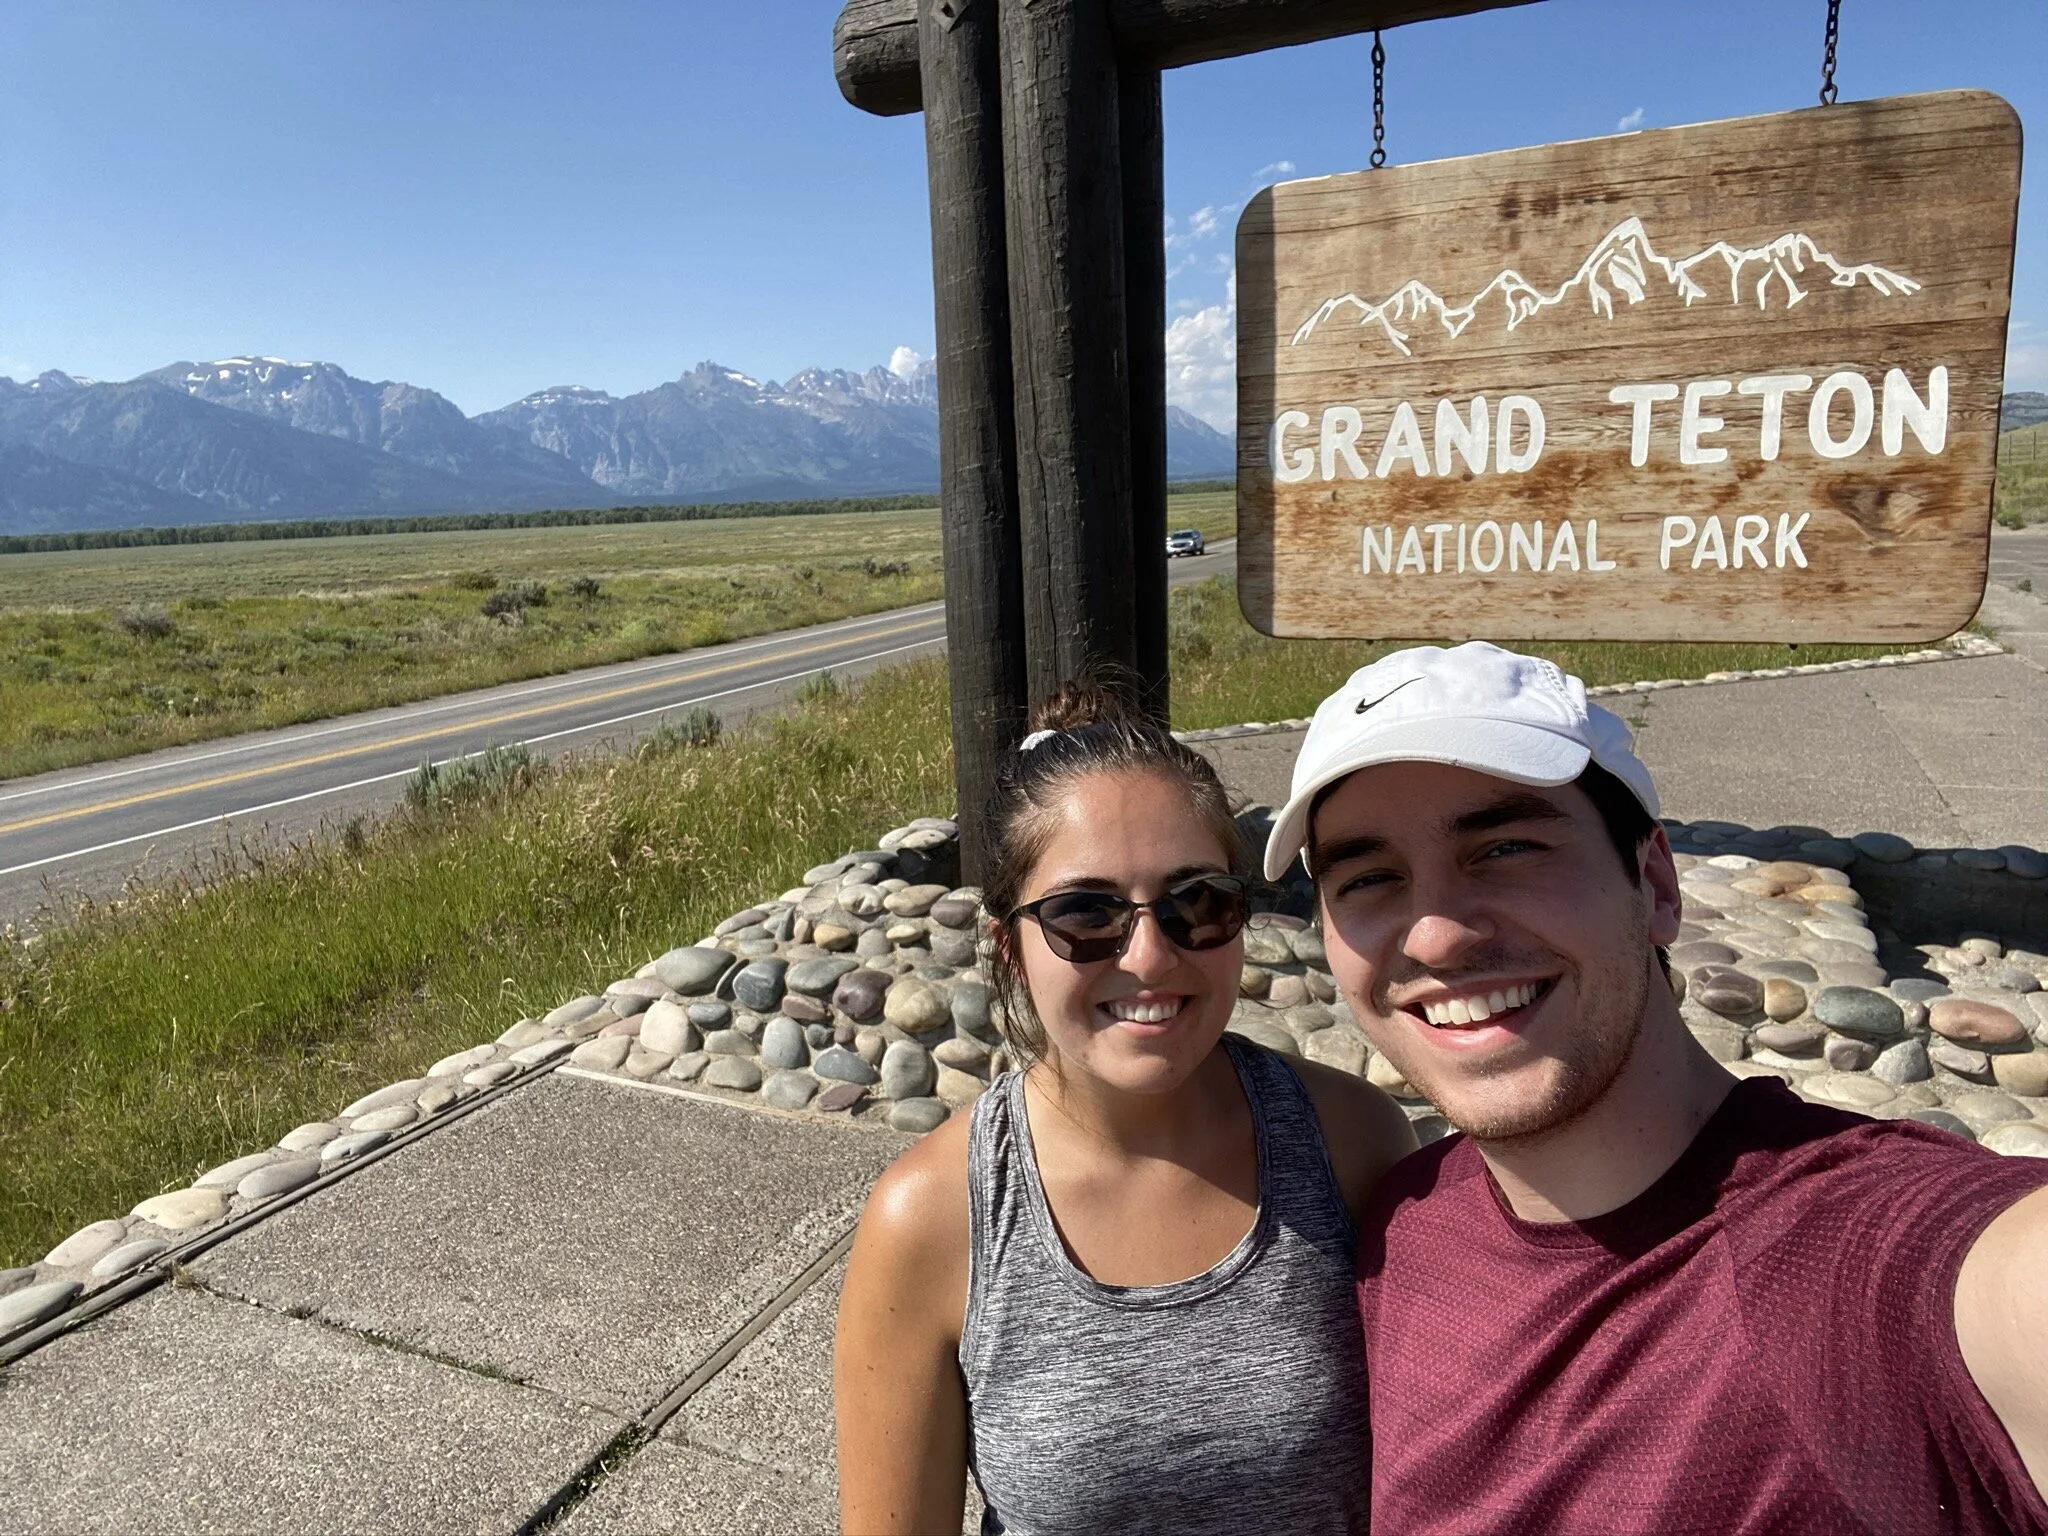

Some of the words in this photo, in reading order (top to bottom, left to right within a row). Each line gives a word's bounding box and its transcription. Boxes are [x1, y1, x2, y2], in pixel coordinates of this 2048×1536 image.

[1269, 395, 1546, 483] GRAND
[1609, 365, 1949, 467] TETON
[1361, 519, 1617, 575] NATIONAL
[1659, 512, 1811, 570] PARK
